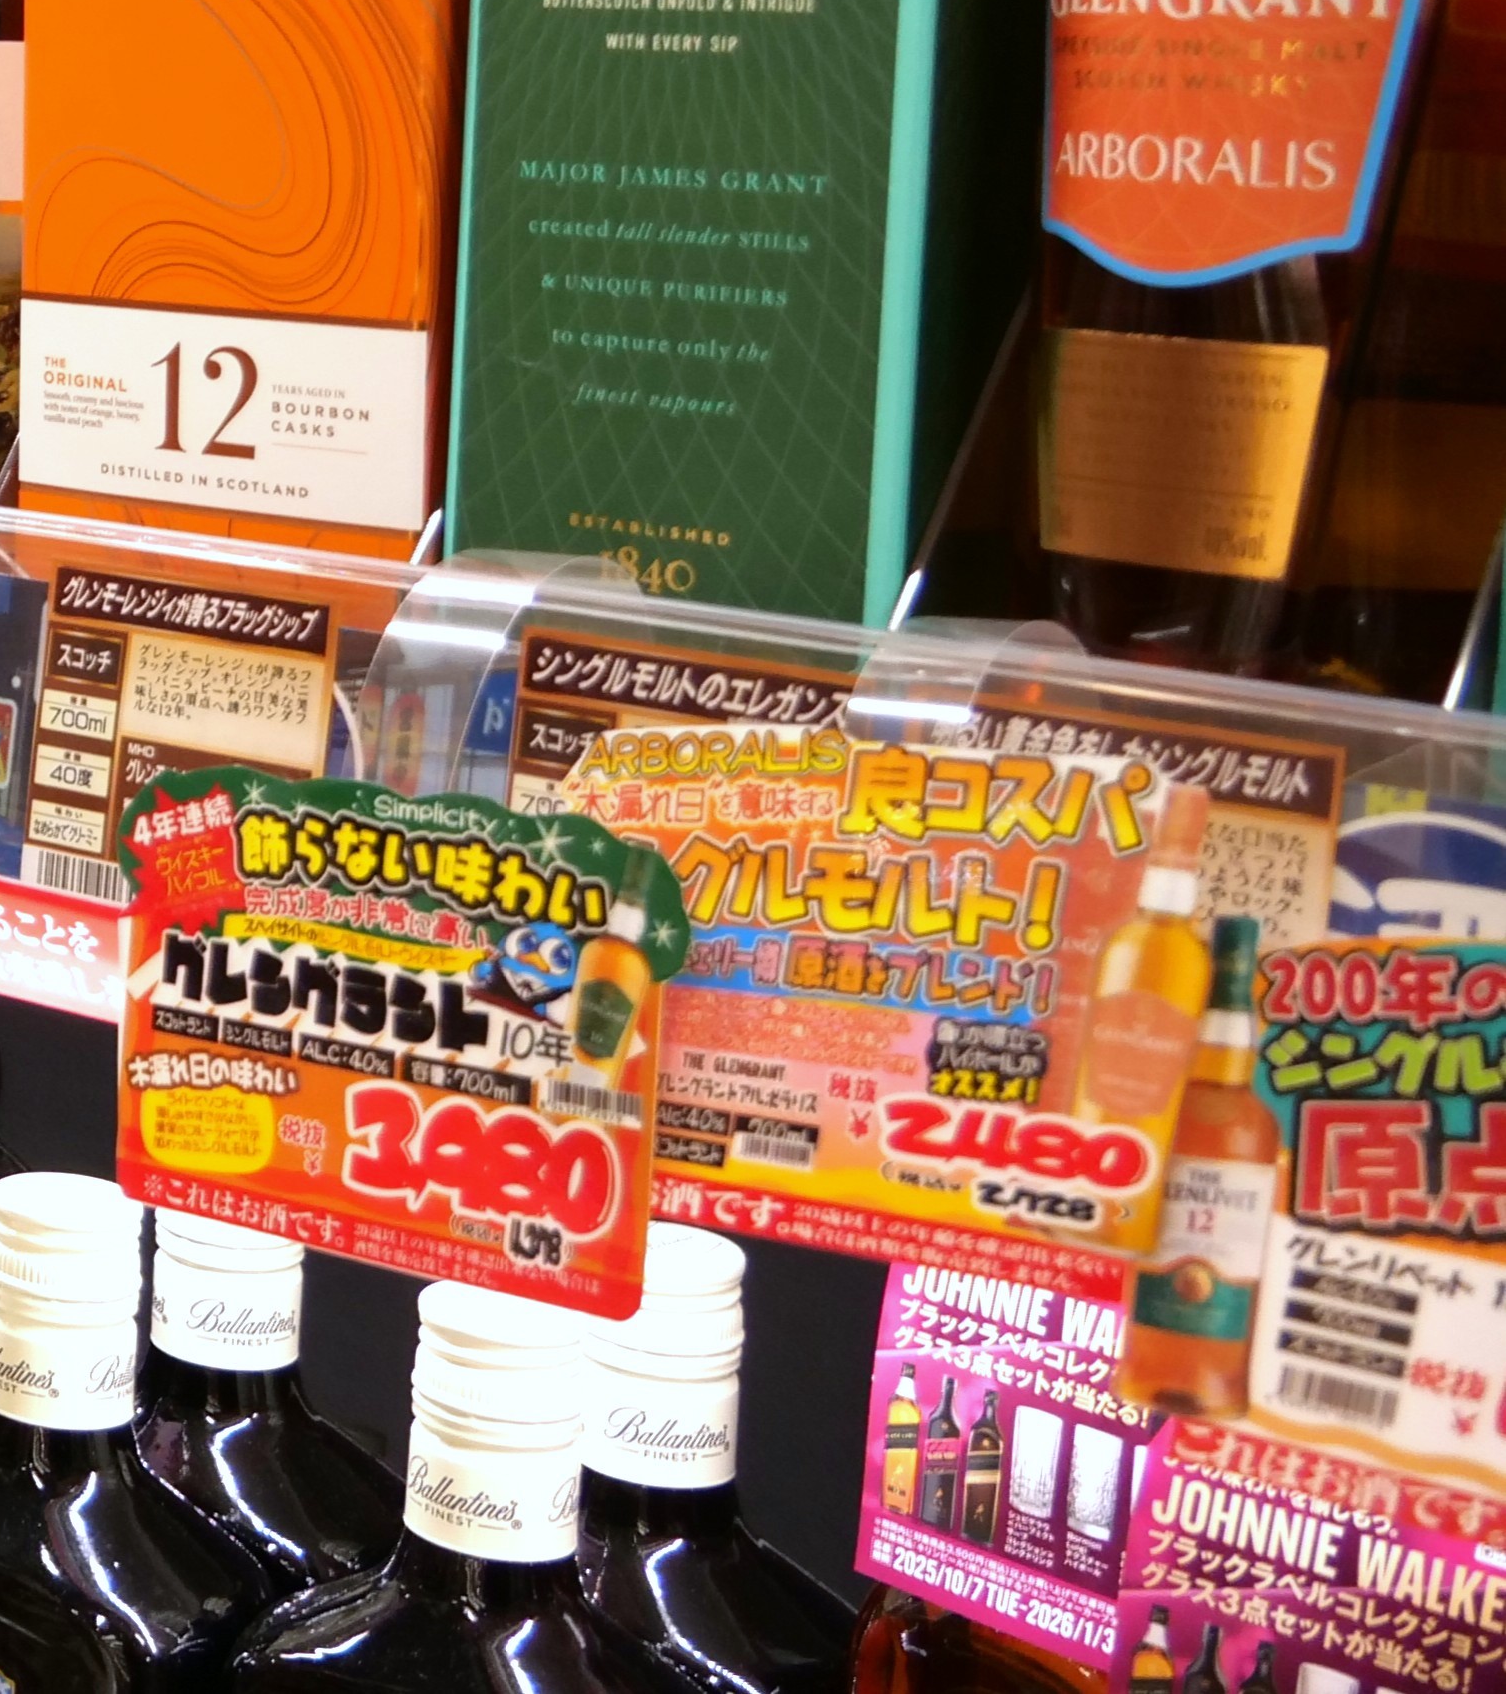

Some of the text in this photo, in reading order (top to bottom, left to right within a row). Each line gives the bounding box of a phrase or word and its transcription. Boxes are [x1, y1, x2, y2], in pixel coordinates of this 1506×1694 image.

[606, 33, 703, 53] WITH EVERY
[519, 159, 828, 196] MAJOR JAMES GRANT
[1055, 132, 1339, 192] ARBORALIS
[565, 273, 789, 306] UNIQUE PURIFIERS
[44, 356, 67, 369] THE
[580, 329, 771, 363] capture only the
[43, 371, 127, 392] ORIGINAL
[151, 341, 258, 460] 12
[271, 402, 370, 422] BOURBON
[271, 421, 336, 437] CASKS
[101, 464, 310, 498] DISTILLED SCOTLAND
[568, 512, 732, 547] ESTABLISHED
[57, 643, 112, 675] スコッチ
[586, 728, 847, 776] ARBORALIS
[373, 794, 493, 837] Simplicity
[839, 745, 1156, 856] 良コスパ
[133, 795, 234, 846] 4年連続
[233, 810, 611, 934] 飾らない味わい
[161, 932, 573, 1067] グレングラント 10年
[128, 1055, 298, 1093] 木漏れ日の味わい
[222, 1336, 270, 1347] FINEST
[893, 1326, 1150, 1429] グラス3点セットが当たる!
[644, 1450, 697, 1462] FINEST
[424, 1502, 473, 1529] FINEST
[1152, 1480, 1338, 1578] JOHNNIE
[1140, 1563, 1474, 1690] グラス3点セットが当たる!
